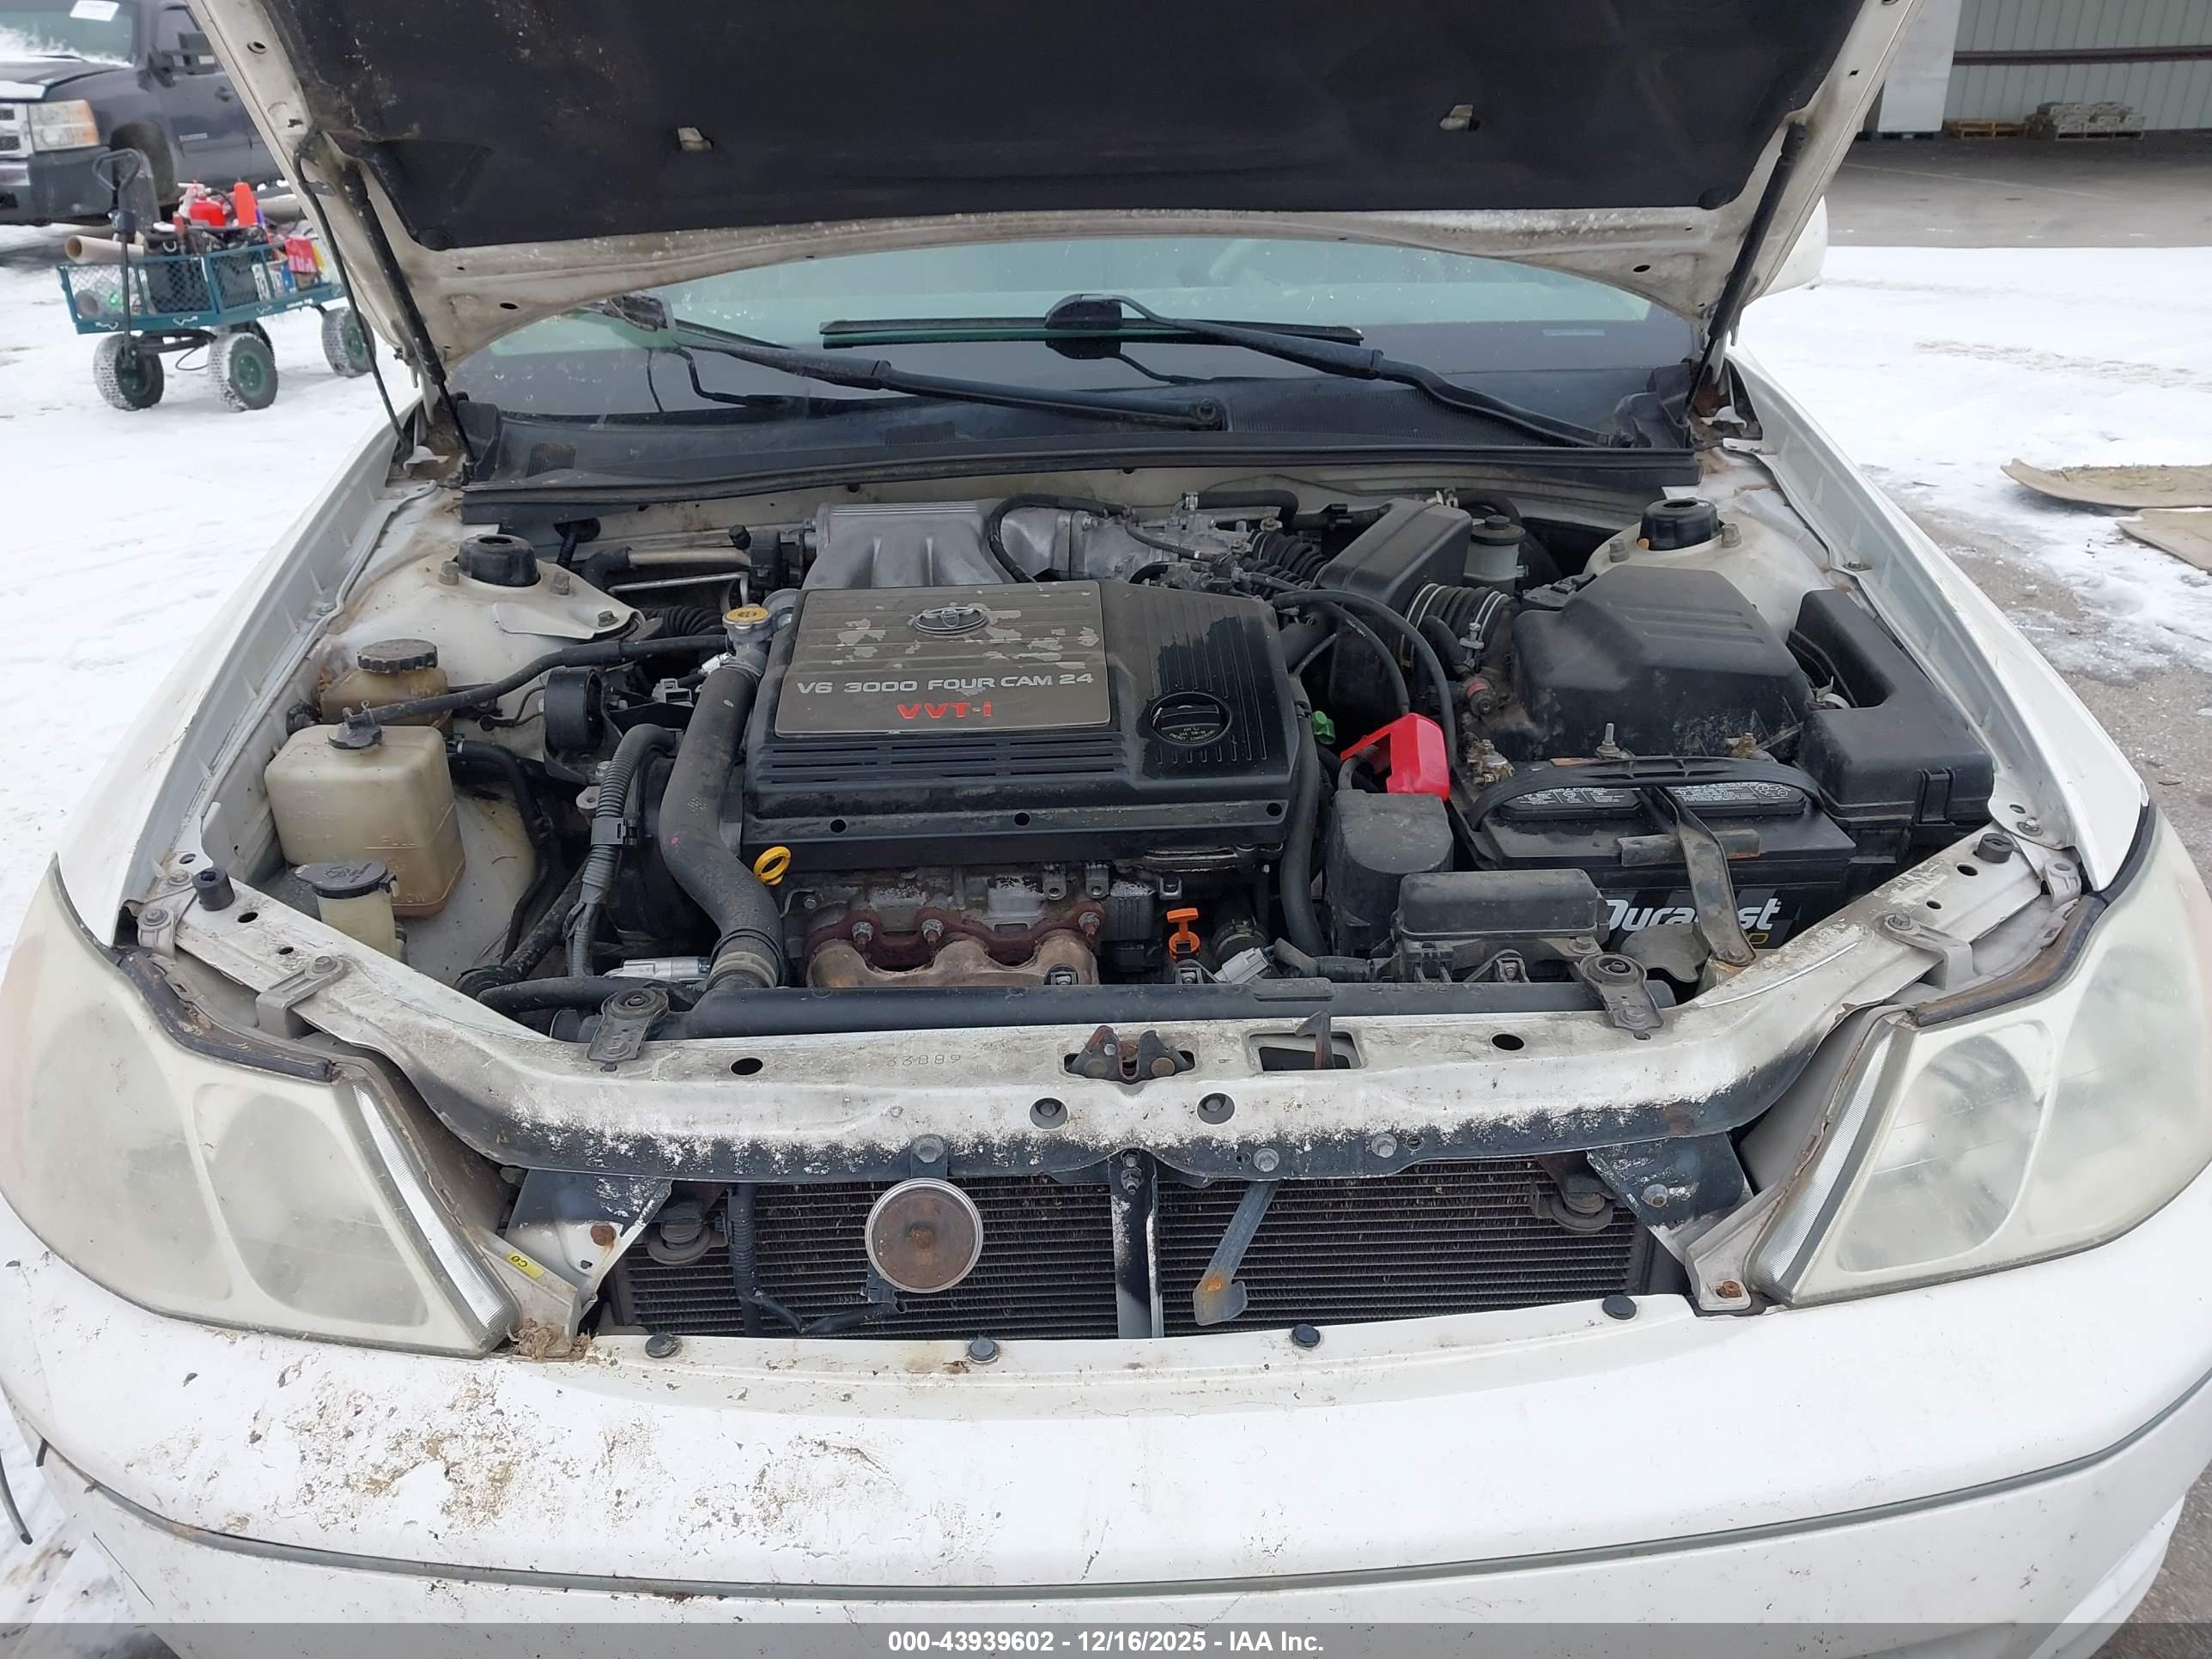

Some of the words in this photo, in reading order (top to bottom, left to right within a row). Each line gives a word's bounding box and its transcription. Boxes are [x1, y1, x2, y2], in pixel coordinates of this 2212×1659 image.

[797, 681, 833, 694] V6
[844, 680, 918, 693] 3000
[927, 677, 996, 691] FOUR
[1000, 675, 1052, 687] CAM
[1059, 672, 1094, 685] 24
[896, 700, 993, 720] VVT-i
[1607, 898, 1781, 933] Durast
